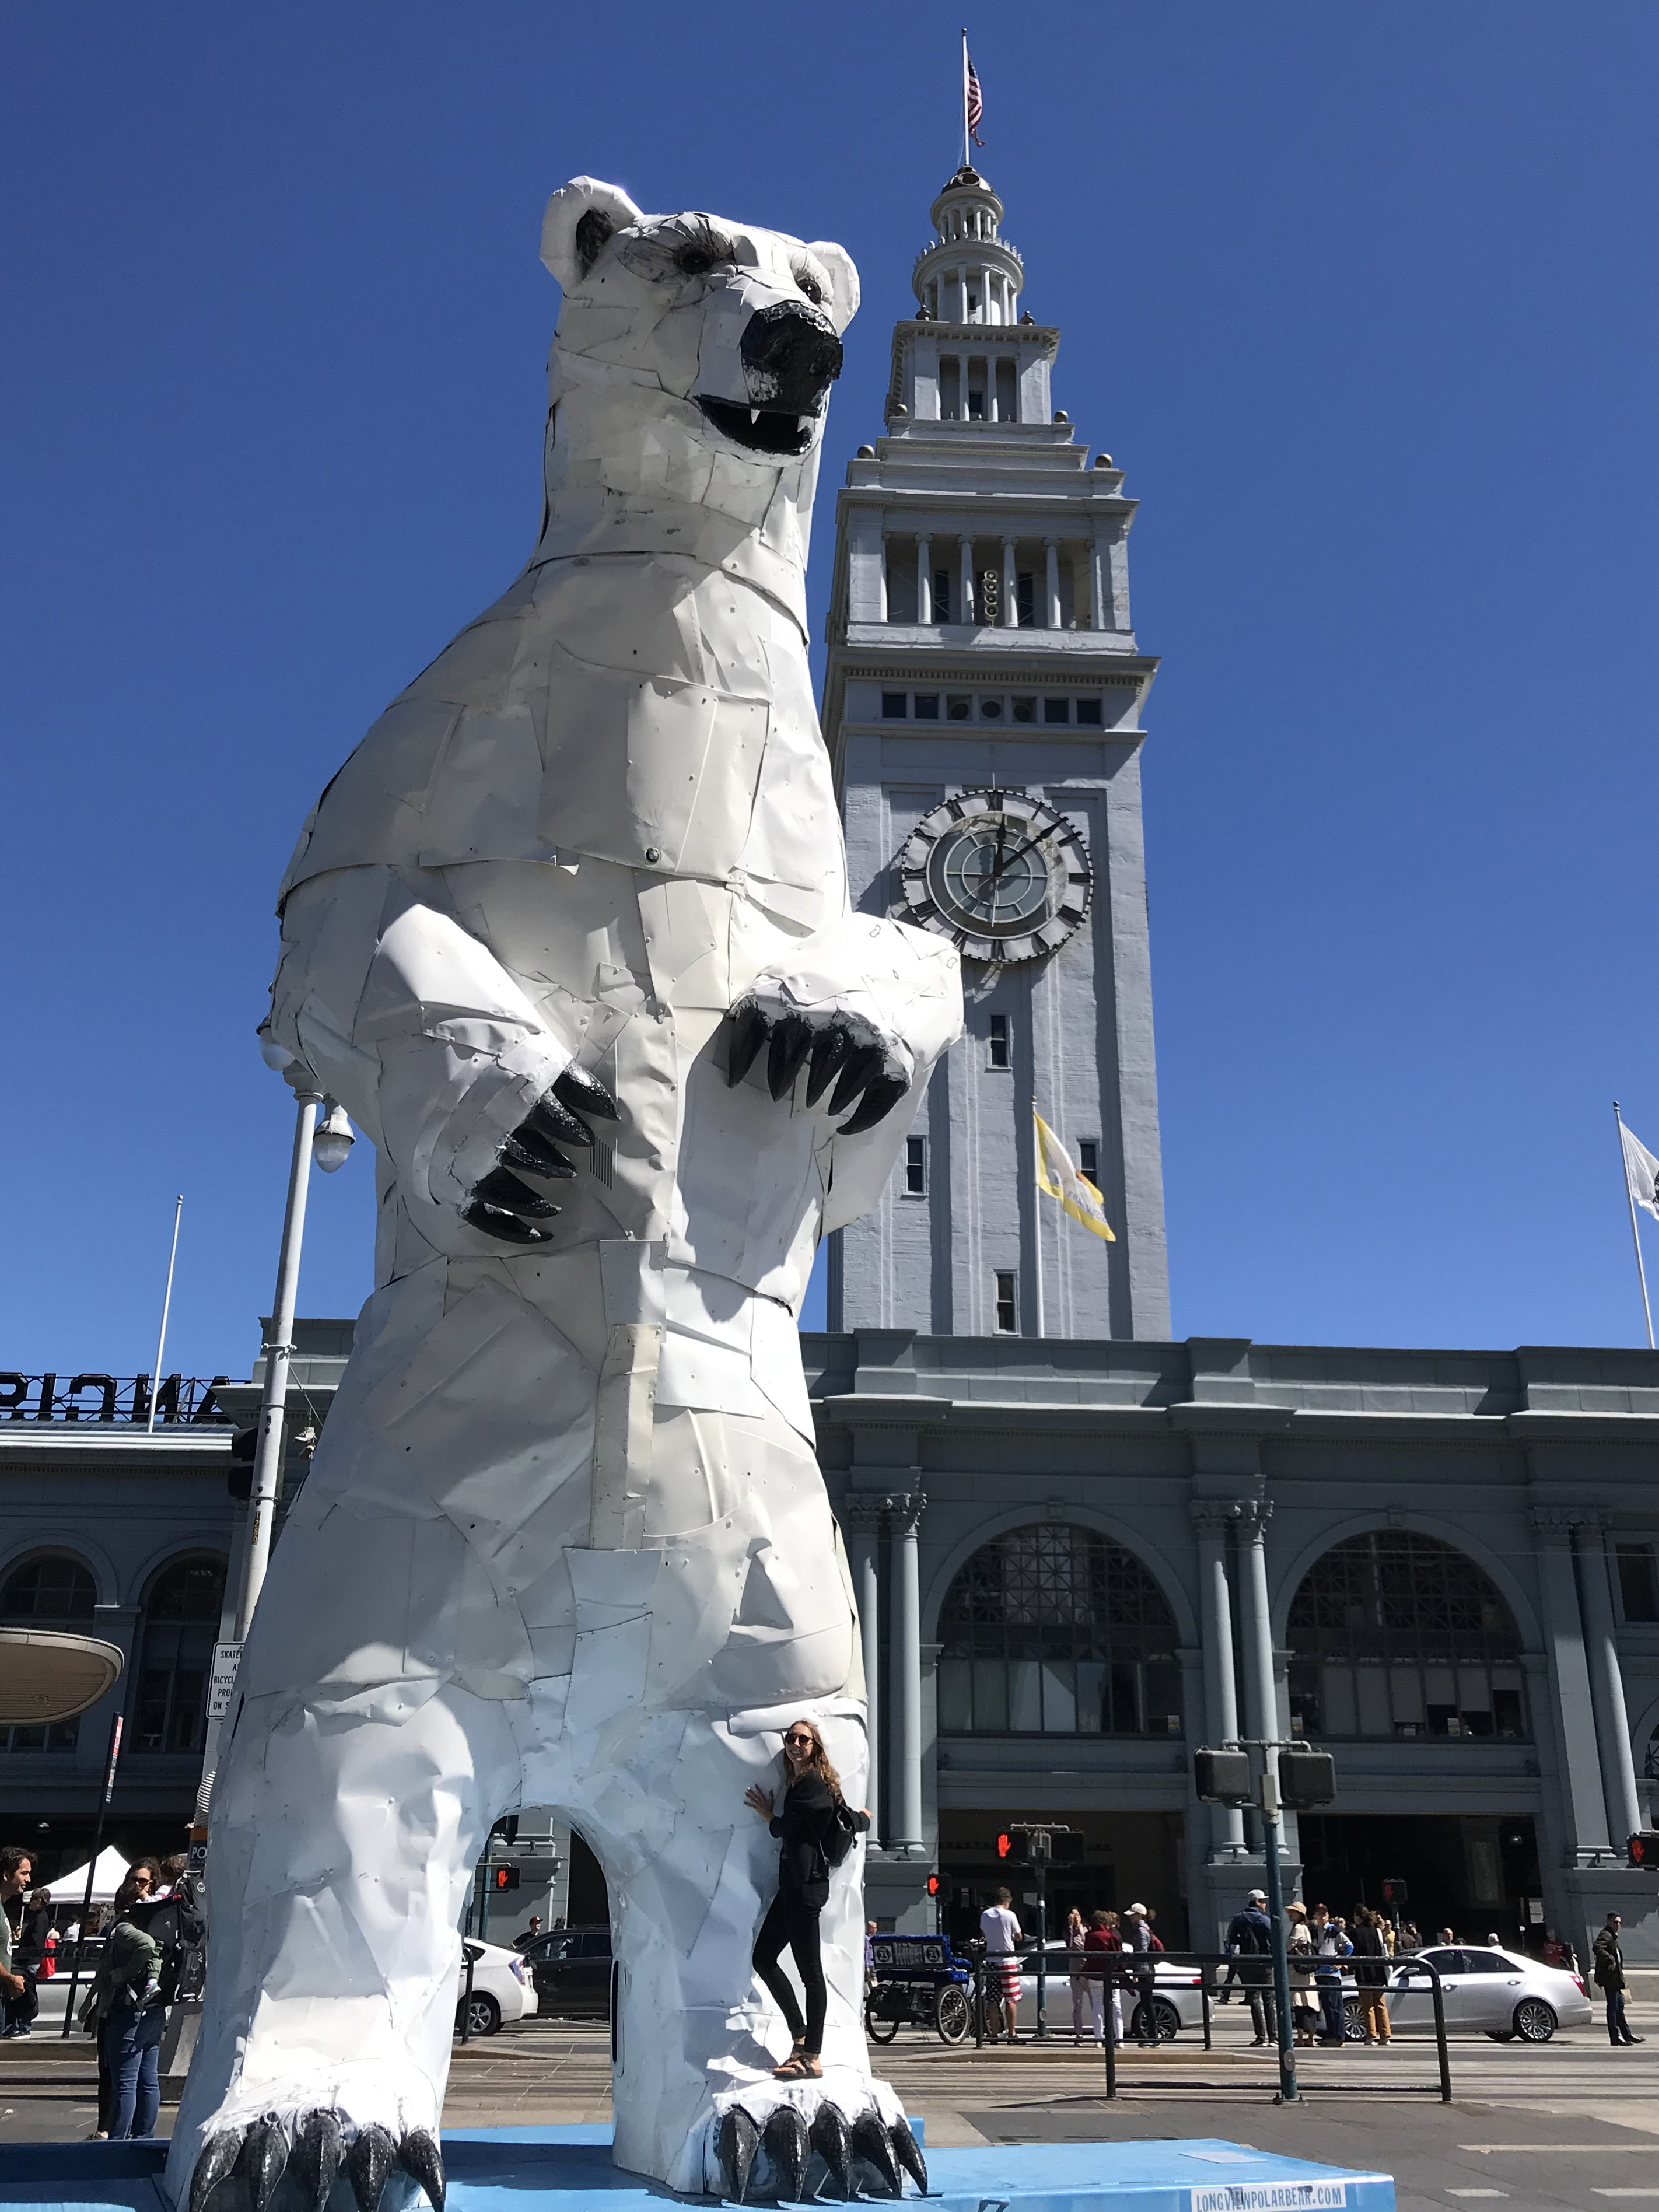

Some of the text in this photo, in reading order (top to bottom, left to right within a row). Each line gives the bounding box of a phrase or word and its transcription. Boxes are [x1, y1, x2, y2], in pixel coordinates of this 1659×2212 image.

[213, 1701, 222, 1710] ON
[879, 1952, 888, 1960] 23
[929, 1951, 938, 1960] 23
